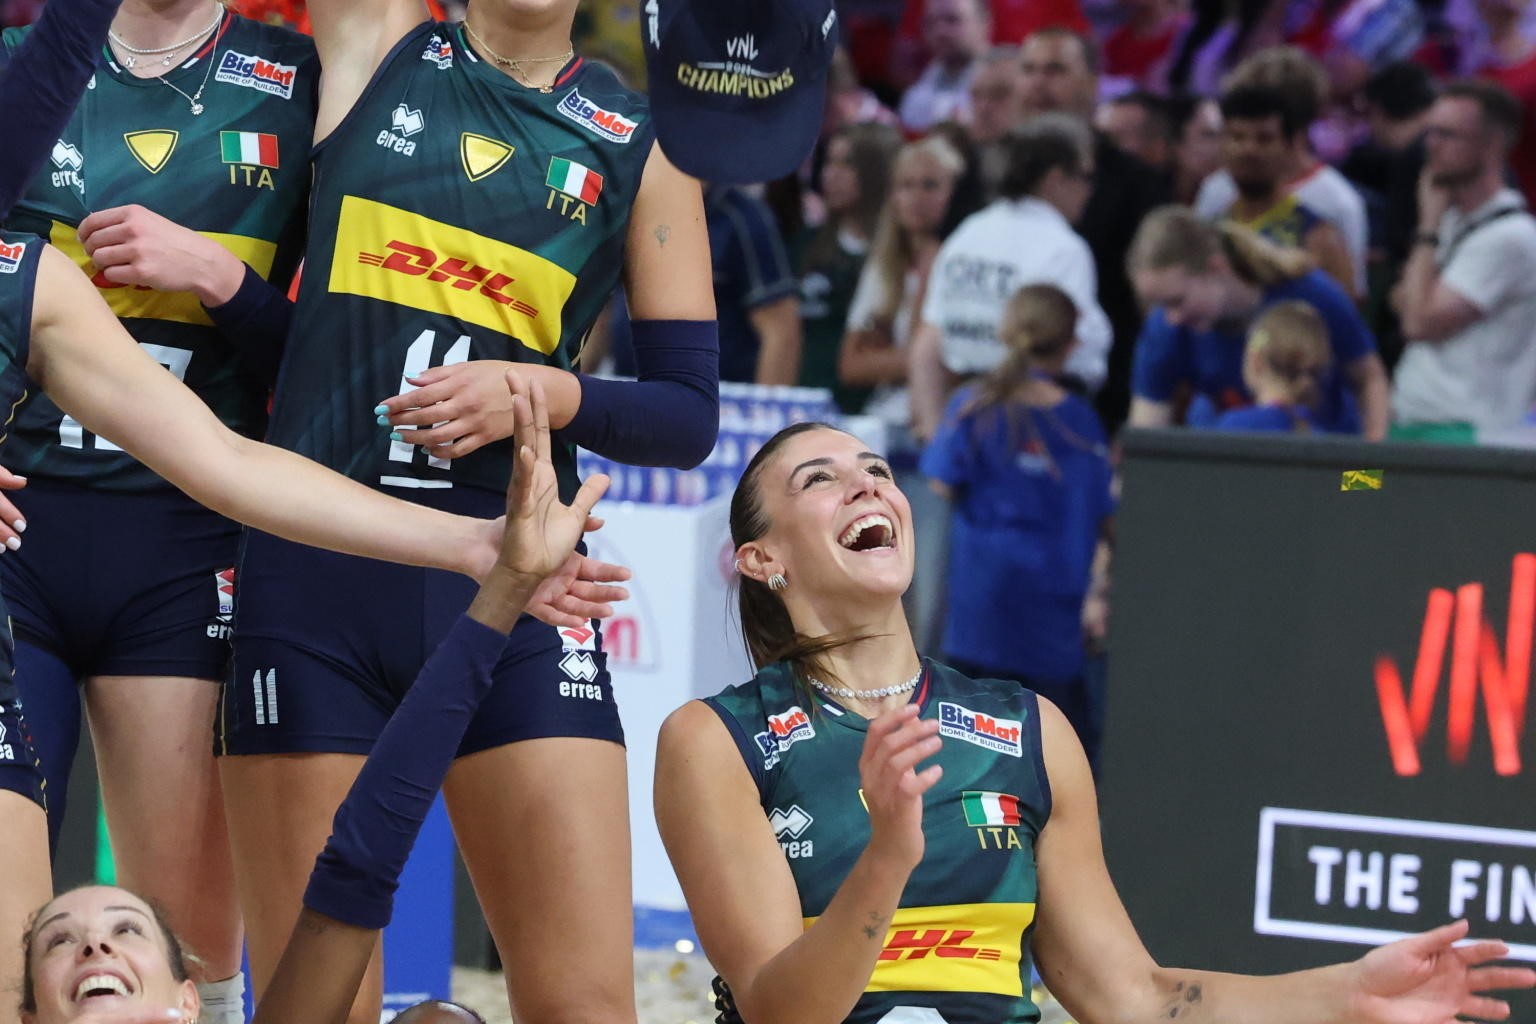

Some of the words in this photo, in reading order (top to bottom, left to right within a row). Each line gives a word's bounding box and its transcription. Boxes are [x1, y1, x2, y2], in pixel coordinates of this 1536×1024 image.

[726, 32, 759, 61] VNL
[221, 52, 293, 85] BigMat
[677, 63, 794, 98] CHAMPIONS
[230, 165, 274, 190] ITA
[546, 189, 586, 226] ITA
[381, 239, 516, 306] DHL
[253, 668, 279, 725] 11
[559, 681, 602, 701] errea
[941, 704, 1019, 743] BigMat
[941, 727, 965, 737] HOME
[967, 734, 978, 742] OF
[980, 739, 1019, 754] BUILDERS
[780, 840, 814, 858] rea
[978, 828, 1022, 850] ITA
[1307, 845, 1422, 915] THE
[878, 930, 979, 961] HL
